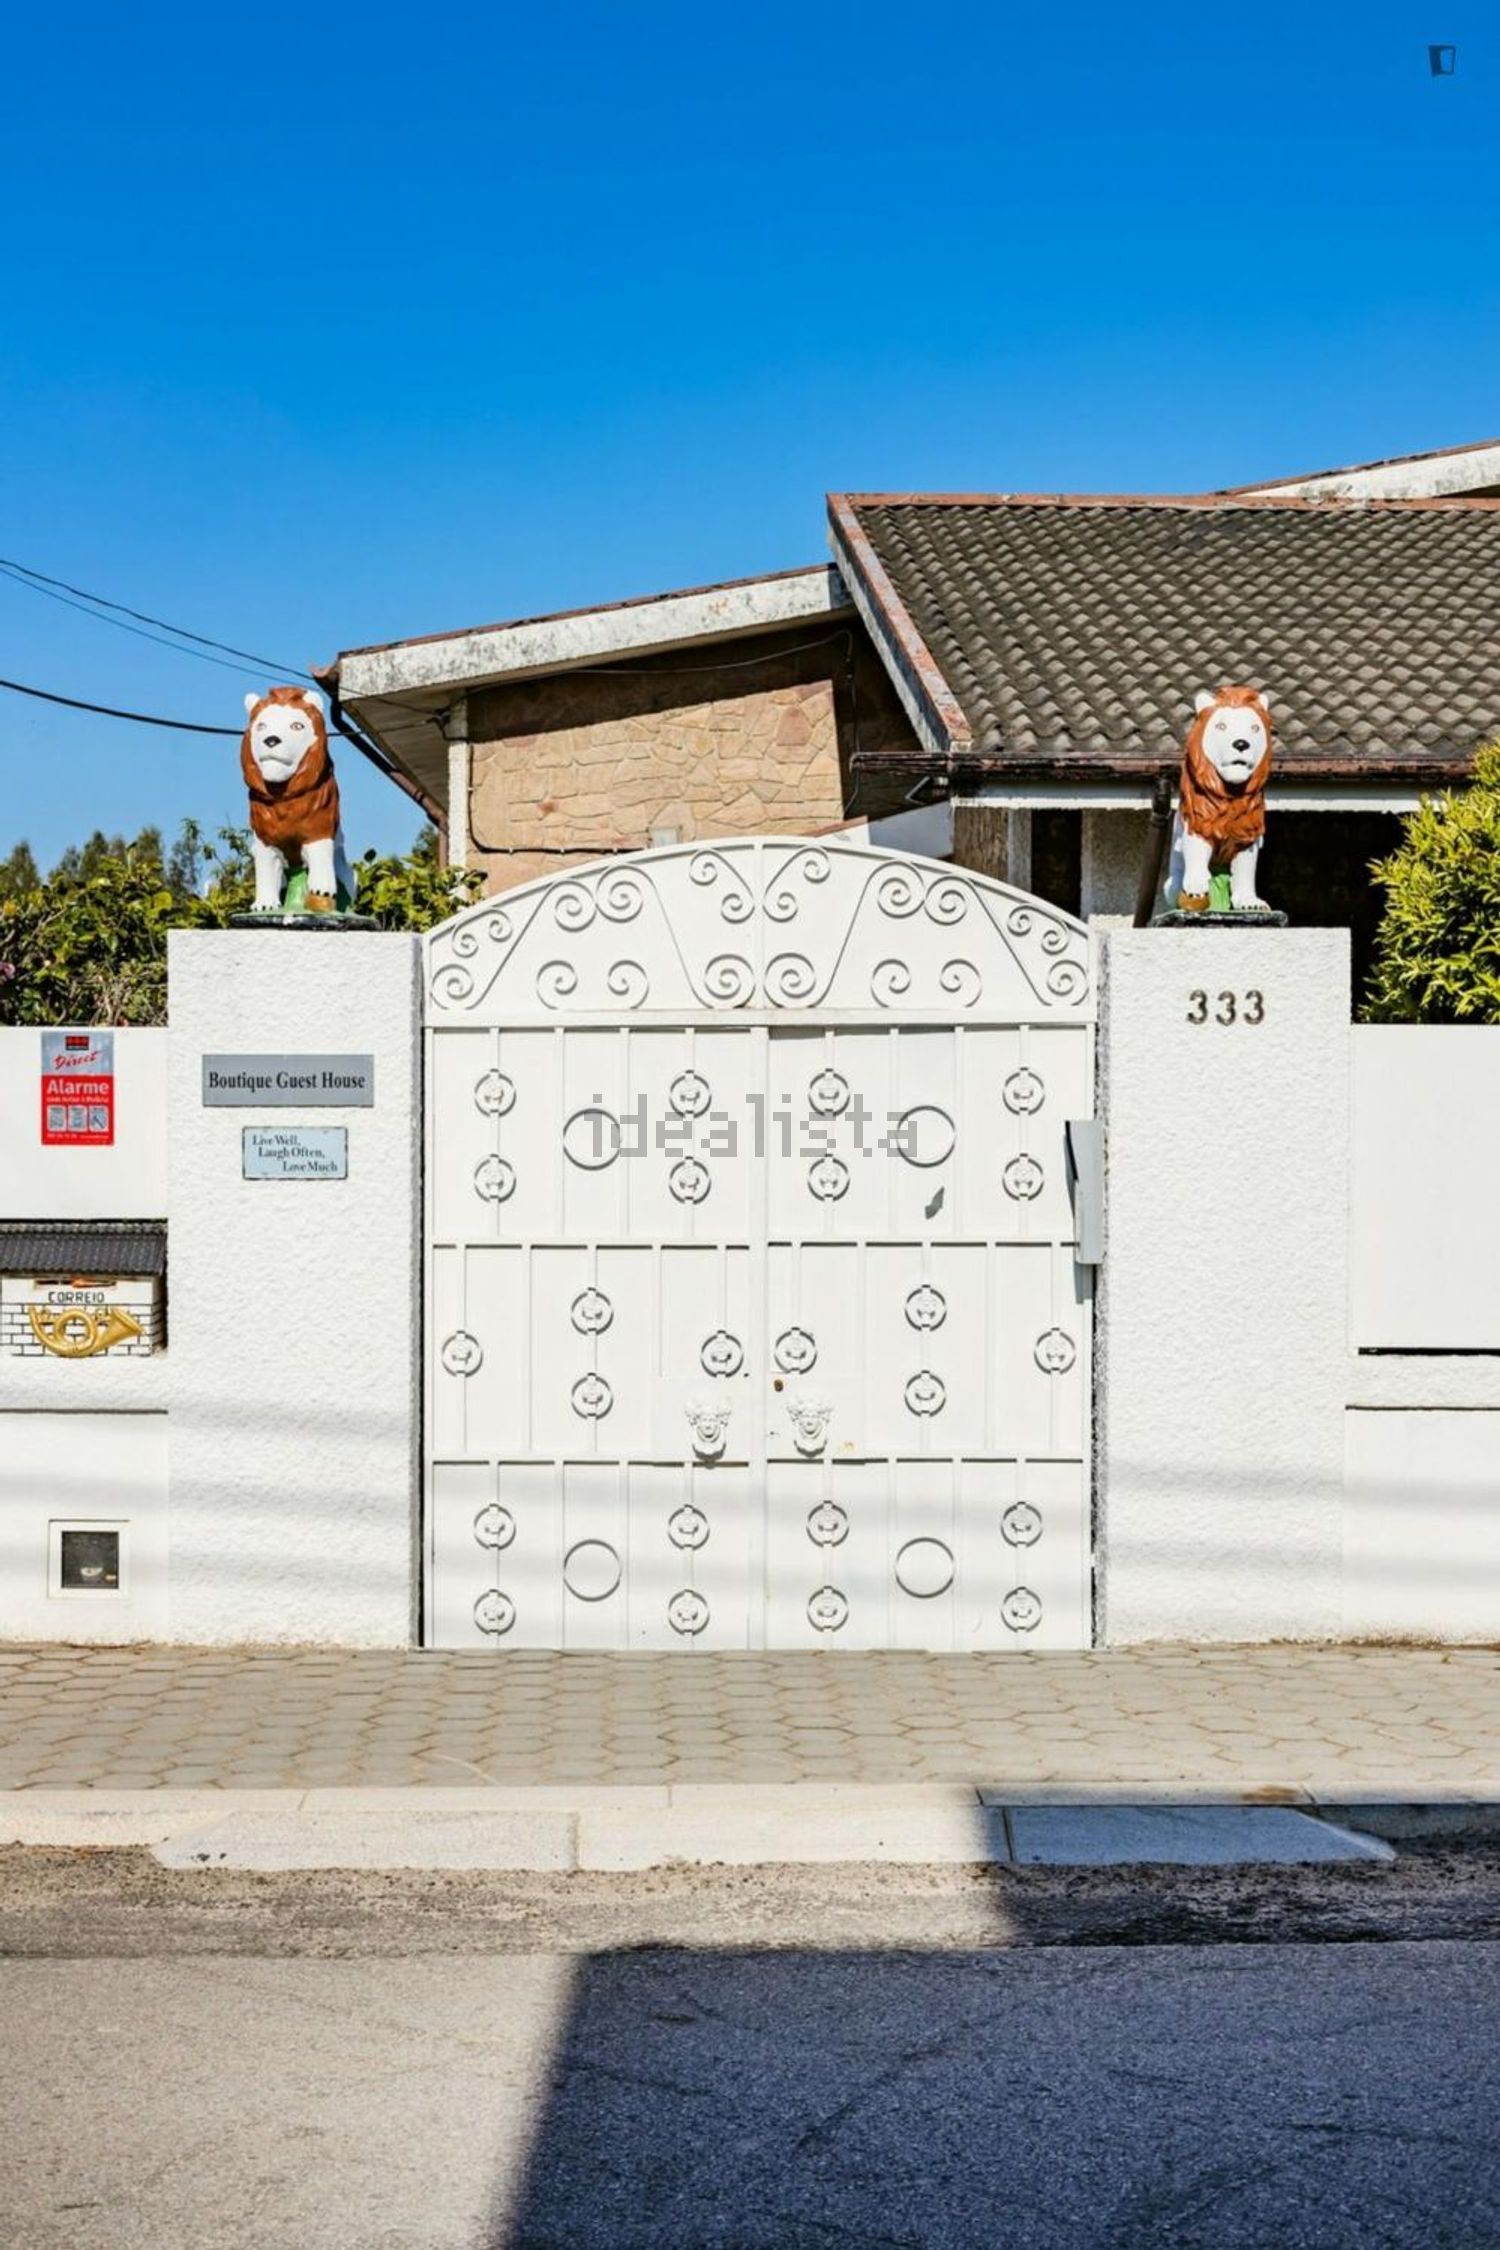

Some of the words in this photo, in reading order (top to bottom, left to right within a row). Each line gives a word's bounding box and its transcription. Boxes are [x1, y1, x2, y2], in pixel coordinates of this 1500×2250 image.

[1186, 989, 1264, 1026] 333
[47, 1079, 109, 1094] Alarme
[209, 1071, 272, 1092] Boutique
[276, 1072, 317, 1088] Guest
[322, 1072, 365, 1088] House
[252, 1135, 273, 1145] Live
[258, 1147, 290, 1160] Laugh
[292, 1147, 325, 1158] Often,
[283, 1161, 306, 1172] Love
[308, 1161, 338, 1172] Much
[48, 1291, 105, 1304] CORREIO
